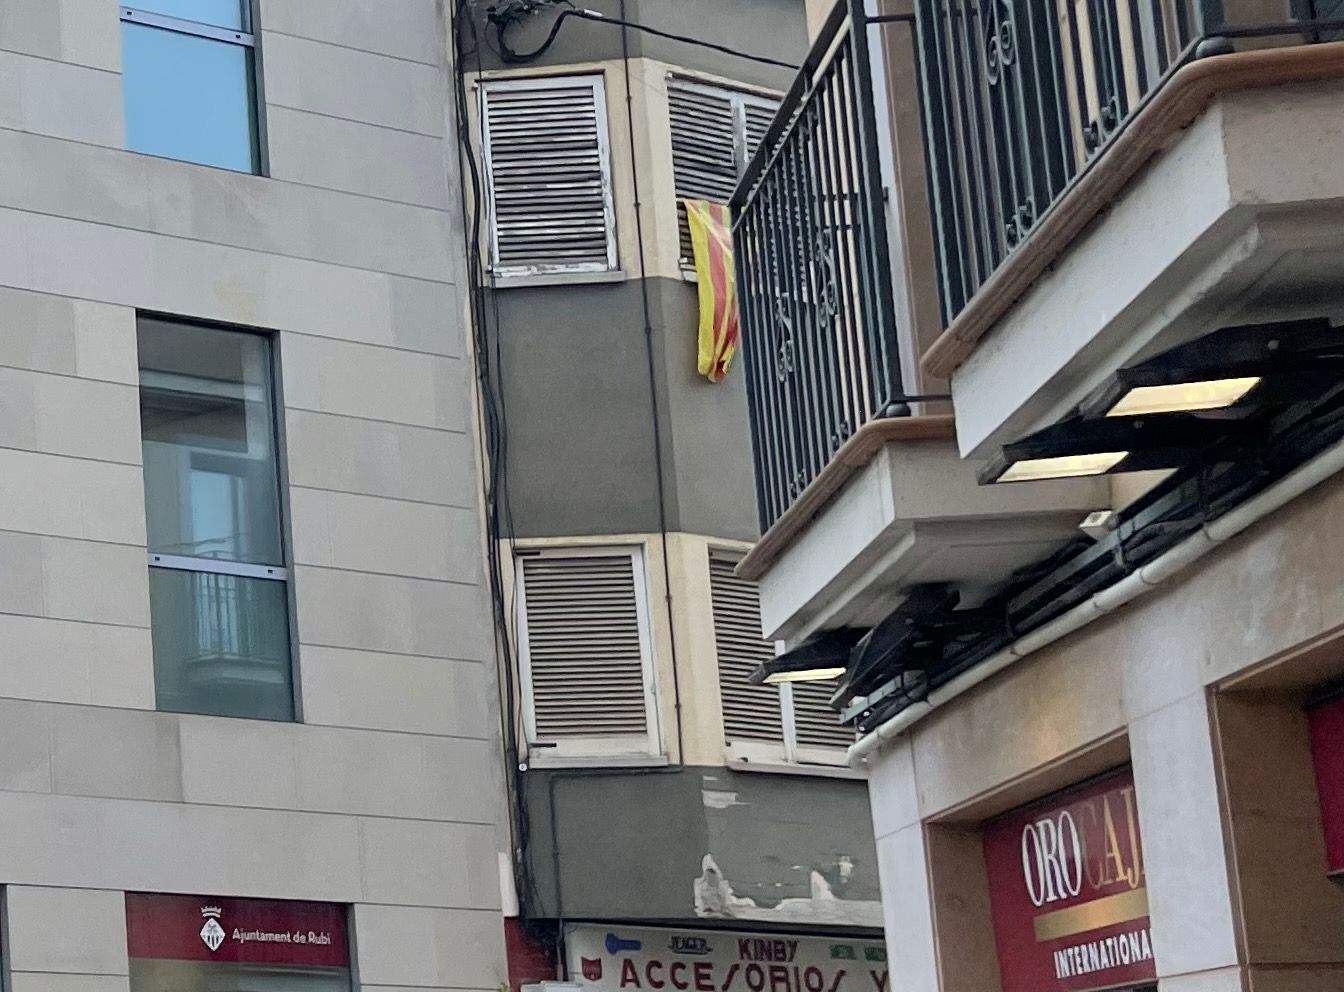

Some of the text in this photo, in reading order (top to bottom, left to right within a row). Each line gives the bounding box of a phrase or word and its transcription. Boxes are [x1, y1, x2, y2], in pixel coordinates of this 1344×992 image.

[232, 927, 291, 943] Ajuntament
[292, 930, 306, 944] de
[737, 938, 799, 962] KINBY
[1054, 928, 1153, 979] INTERNATIONA
